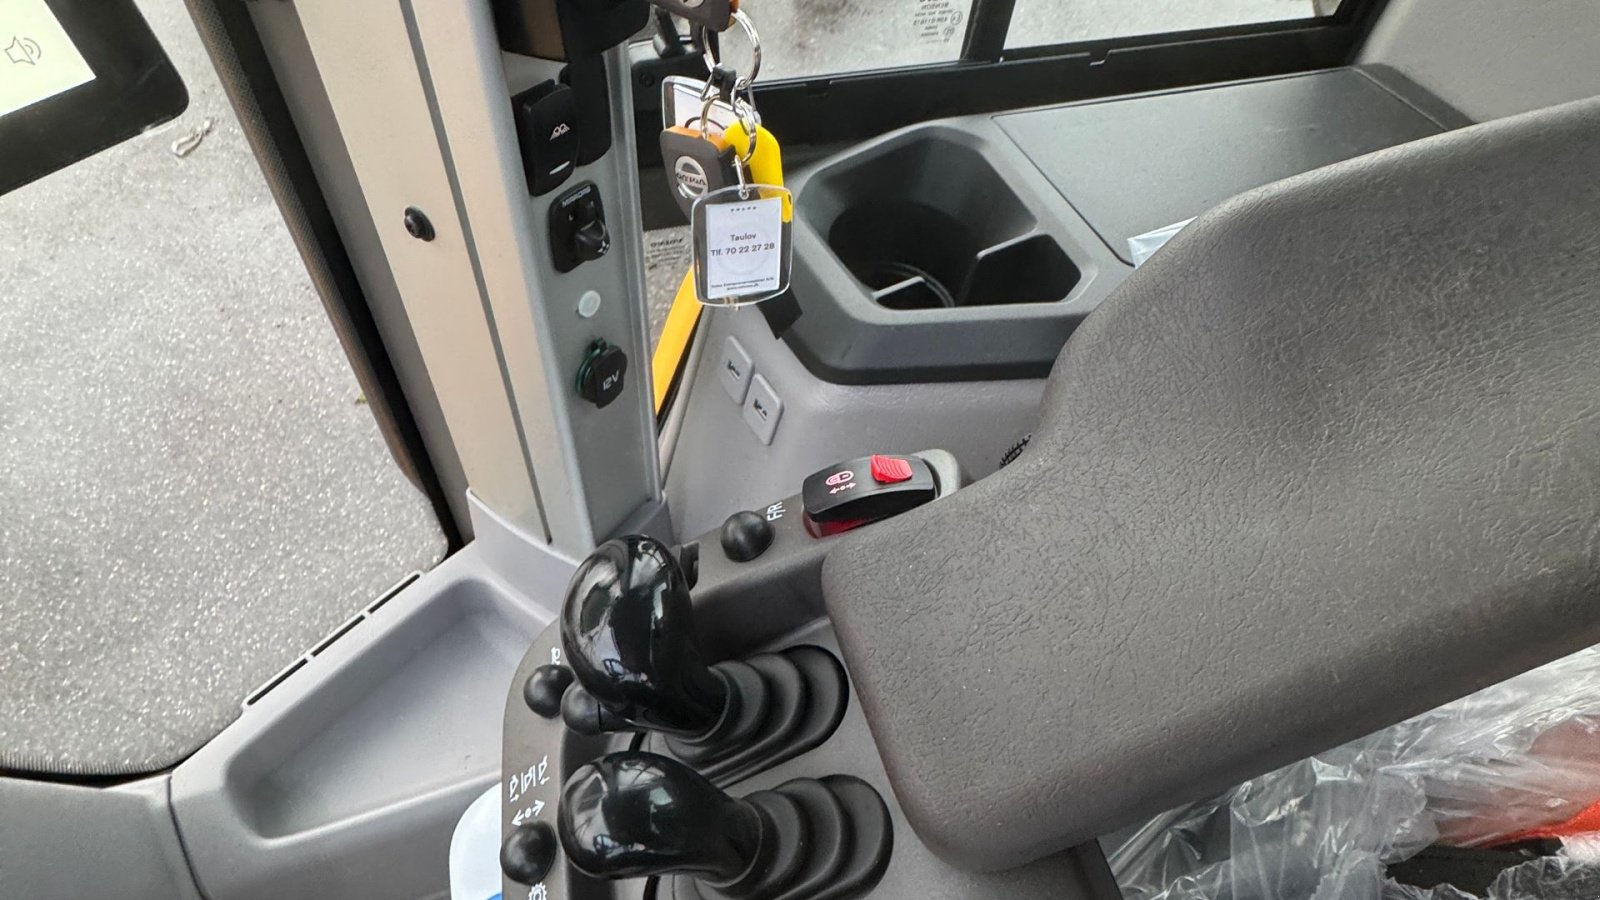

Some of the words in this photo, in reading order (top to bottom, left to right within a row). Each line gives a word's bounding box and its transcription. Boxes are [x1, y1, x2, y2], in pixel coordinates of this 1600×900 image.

[730, 233, 757, 241] Taulov
[725, 247, 737, 255] 70
[738, 245, 750, 254] 22
[752, 244, 762, 252] 27
[764, 242, 775, 250] 28
[603, 370, 619, 391] 12V
